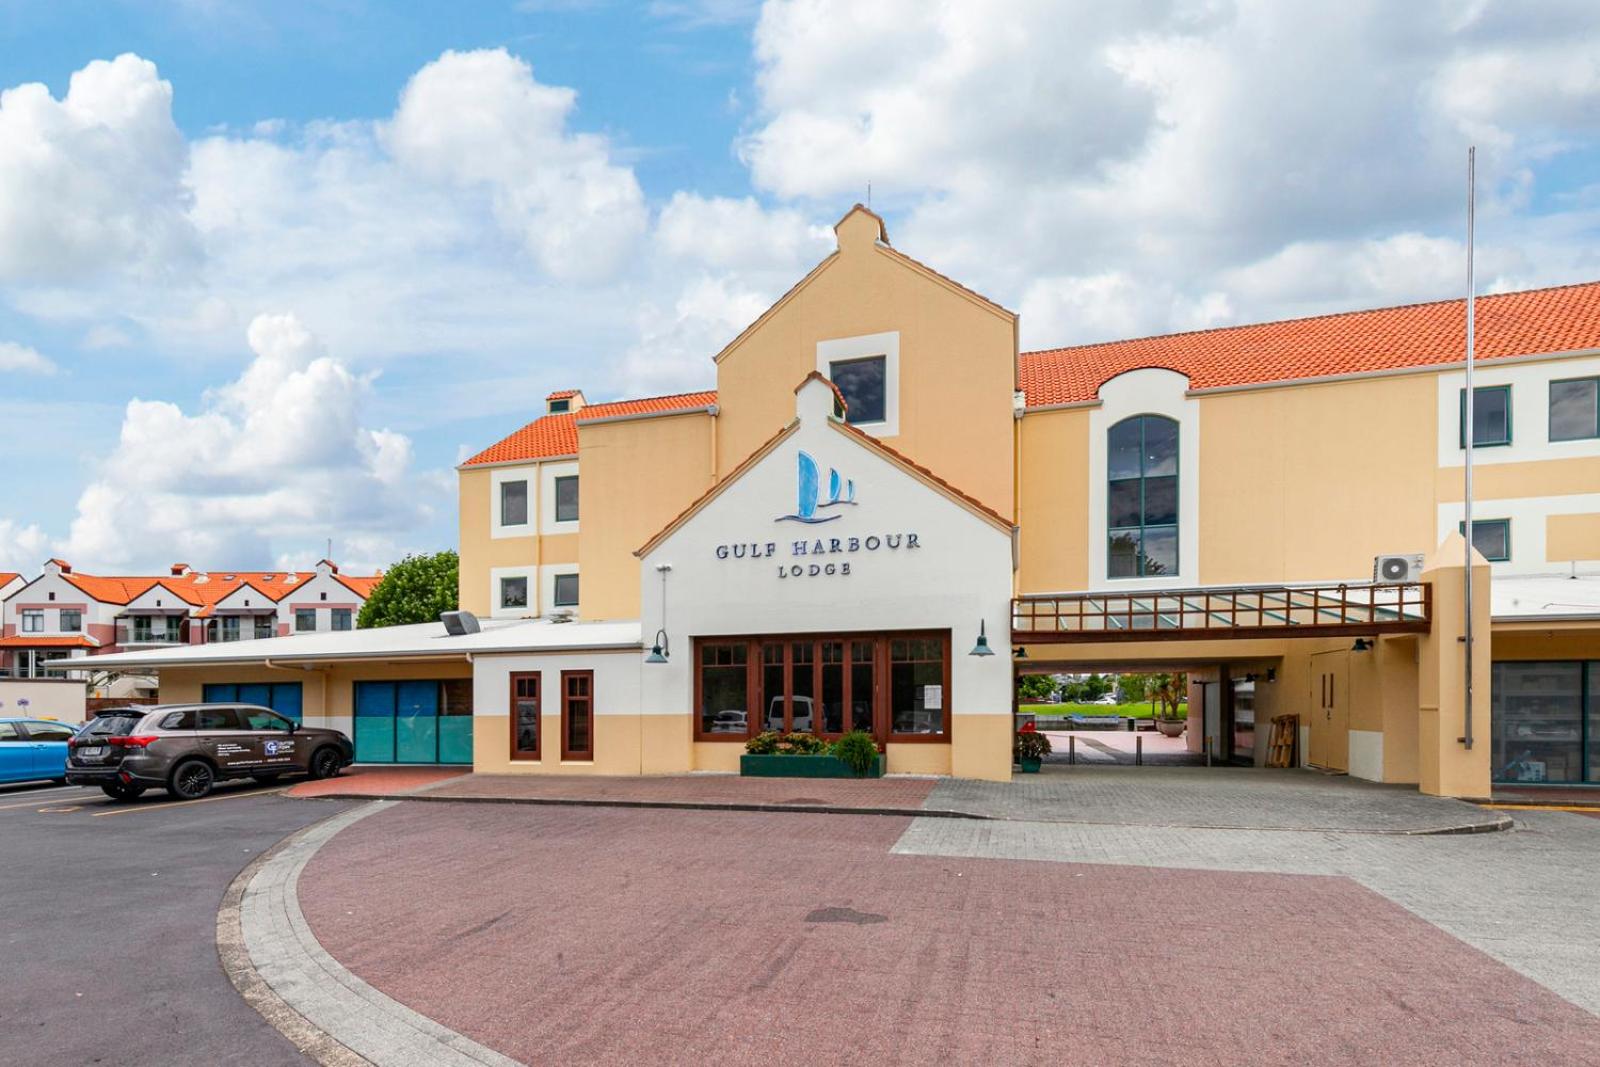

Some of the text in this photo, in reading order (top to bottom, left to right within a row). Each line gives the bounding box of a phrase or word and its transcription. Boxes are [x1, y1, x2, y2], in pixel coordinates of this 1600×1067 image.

[716, 533, 921, 560] GULF HARBOUR
[777, 562, 851, 579] LODGE
